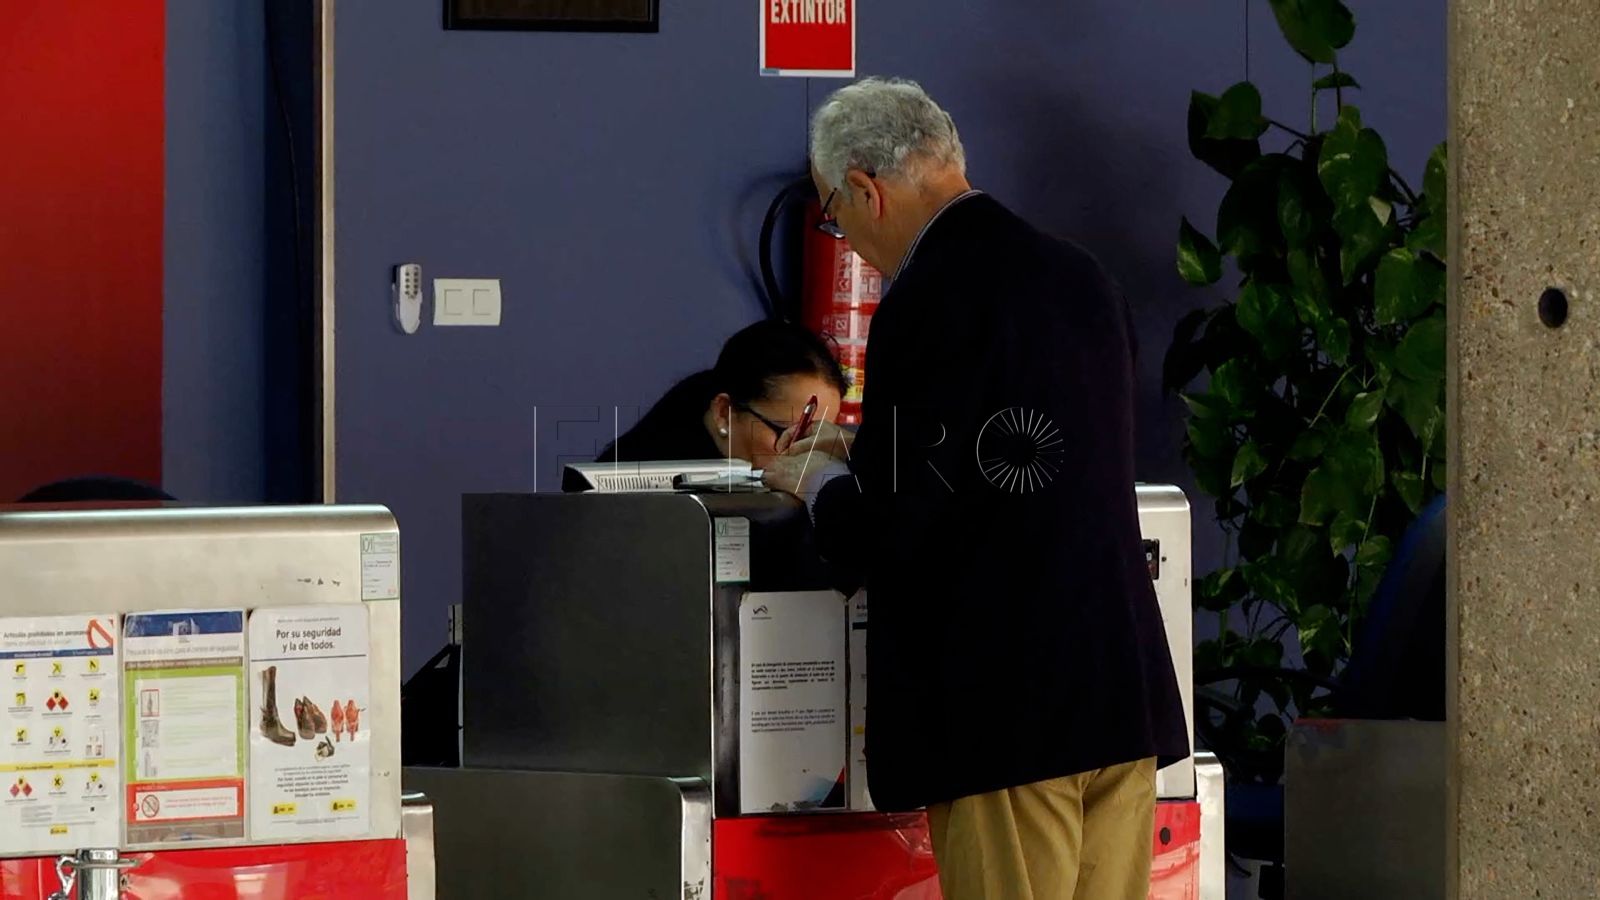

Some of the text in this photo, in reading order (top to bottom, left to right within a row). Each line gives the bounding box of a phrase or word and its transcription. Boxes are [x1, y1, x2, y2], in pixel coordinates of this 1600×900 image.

[770, 0, 847, 24] EXTINTOR
[276, 629, 290, 639] Por
[303, 627, 341, 639] seguridad
[282, 643, 288, 653] y
[289, 642, 297, 651] la
[298, 641, 309, 651] de
